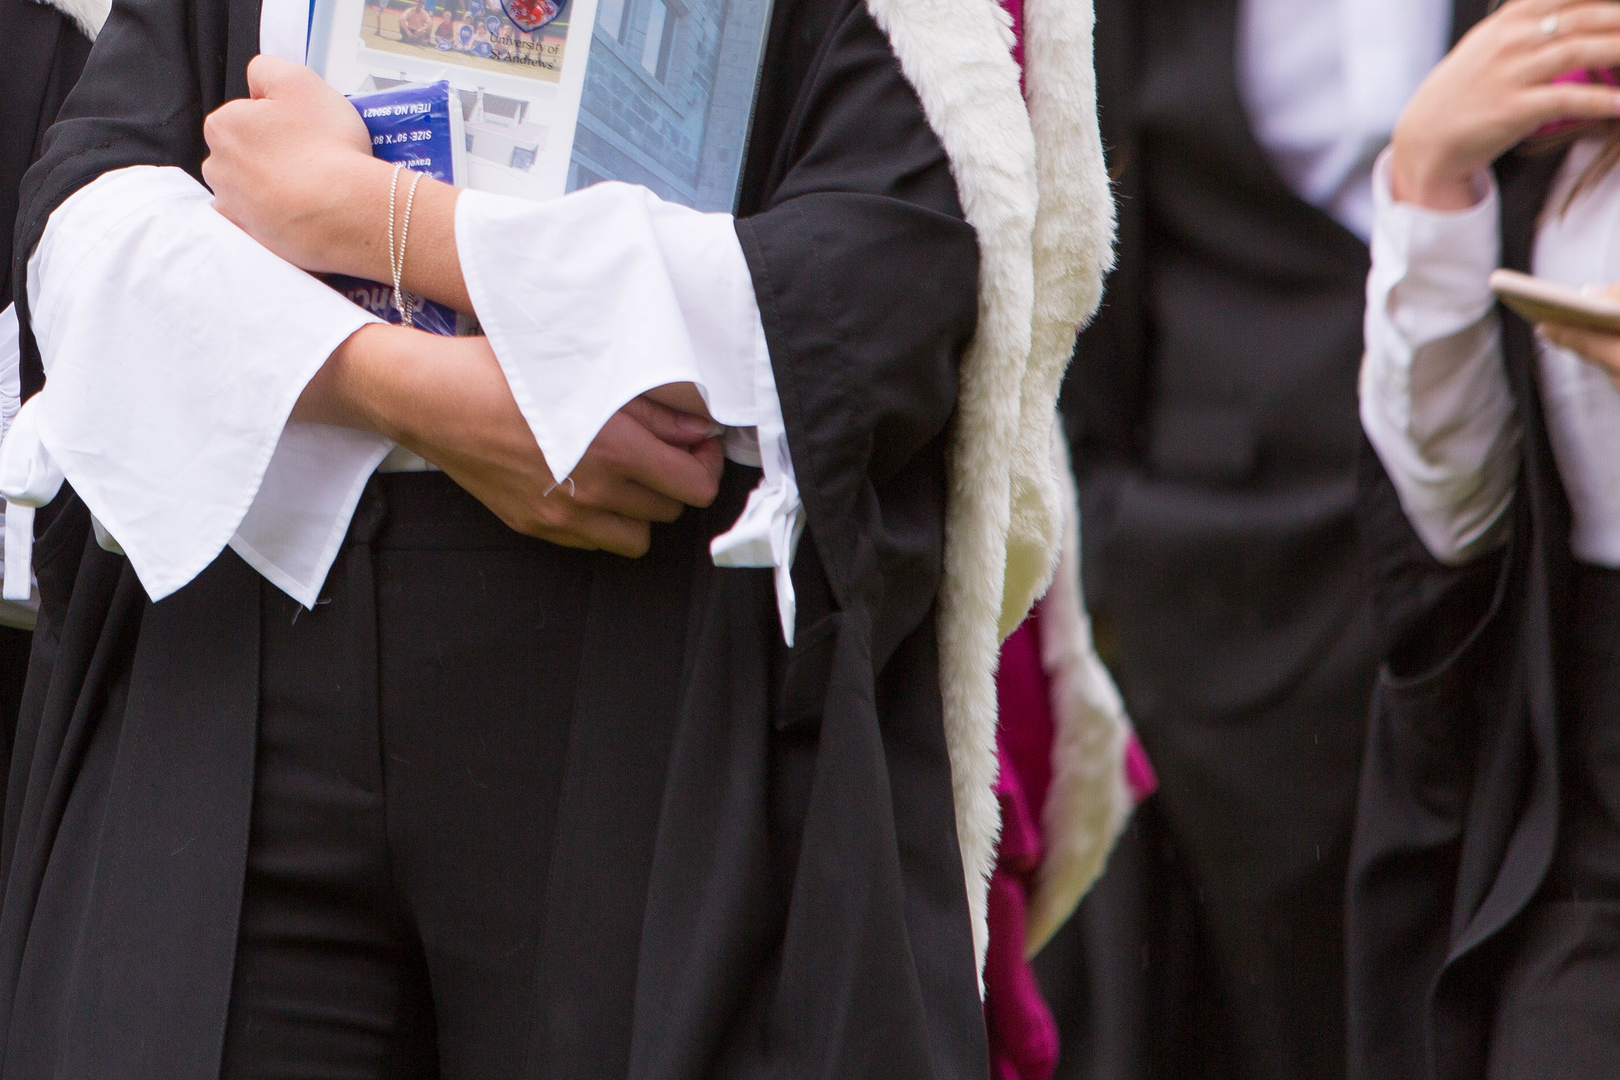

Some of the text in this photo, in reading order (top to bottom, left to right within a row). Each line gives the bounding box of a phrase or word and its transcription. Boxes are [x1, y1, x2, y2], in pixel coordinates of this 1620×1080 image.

[490, 32, 560, 55] University of
[490, 48, 554, 69] St Andrews
[362, 102, 432, 119] ITEM NO. 950421
[408, 129, 432, 142] SIZE:
[407, 158, 432, 169] travel
